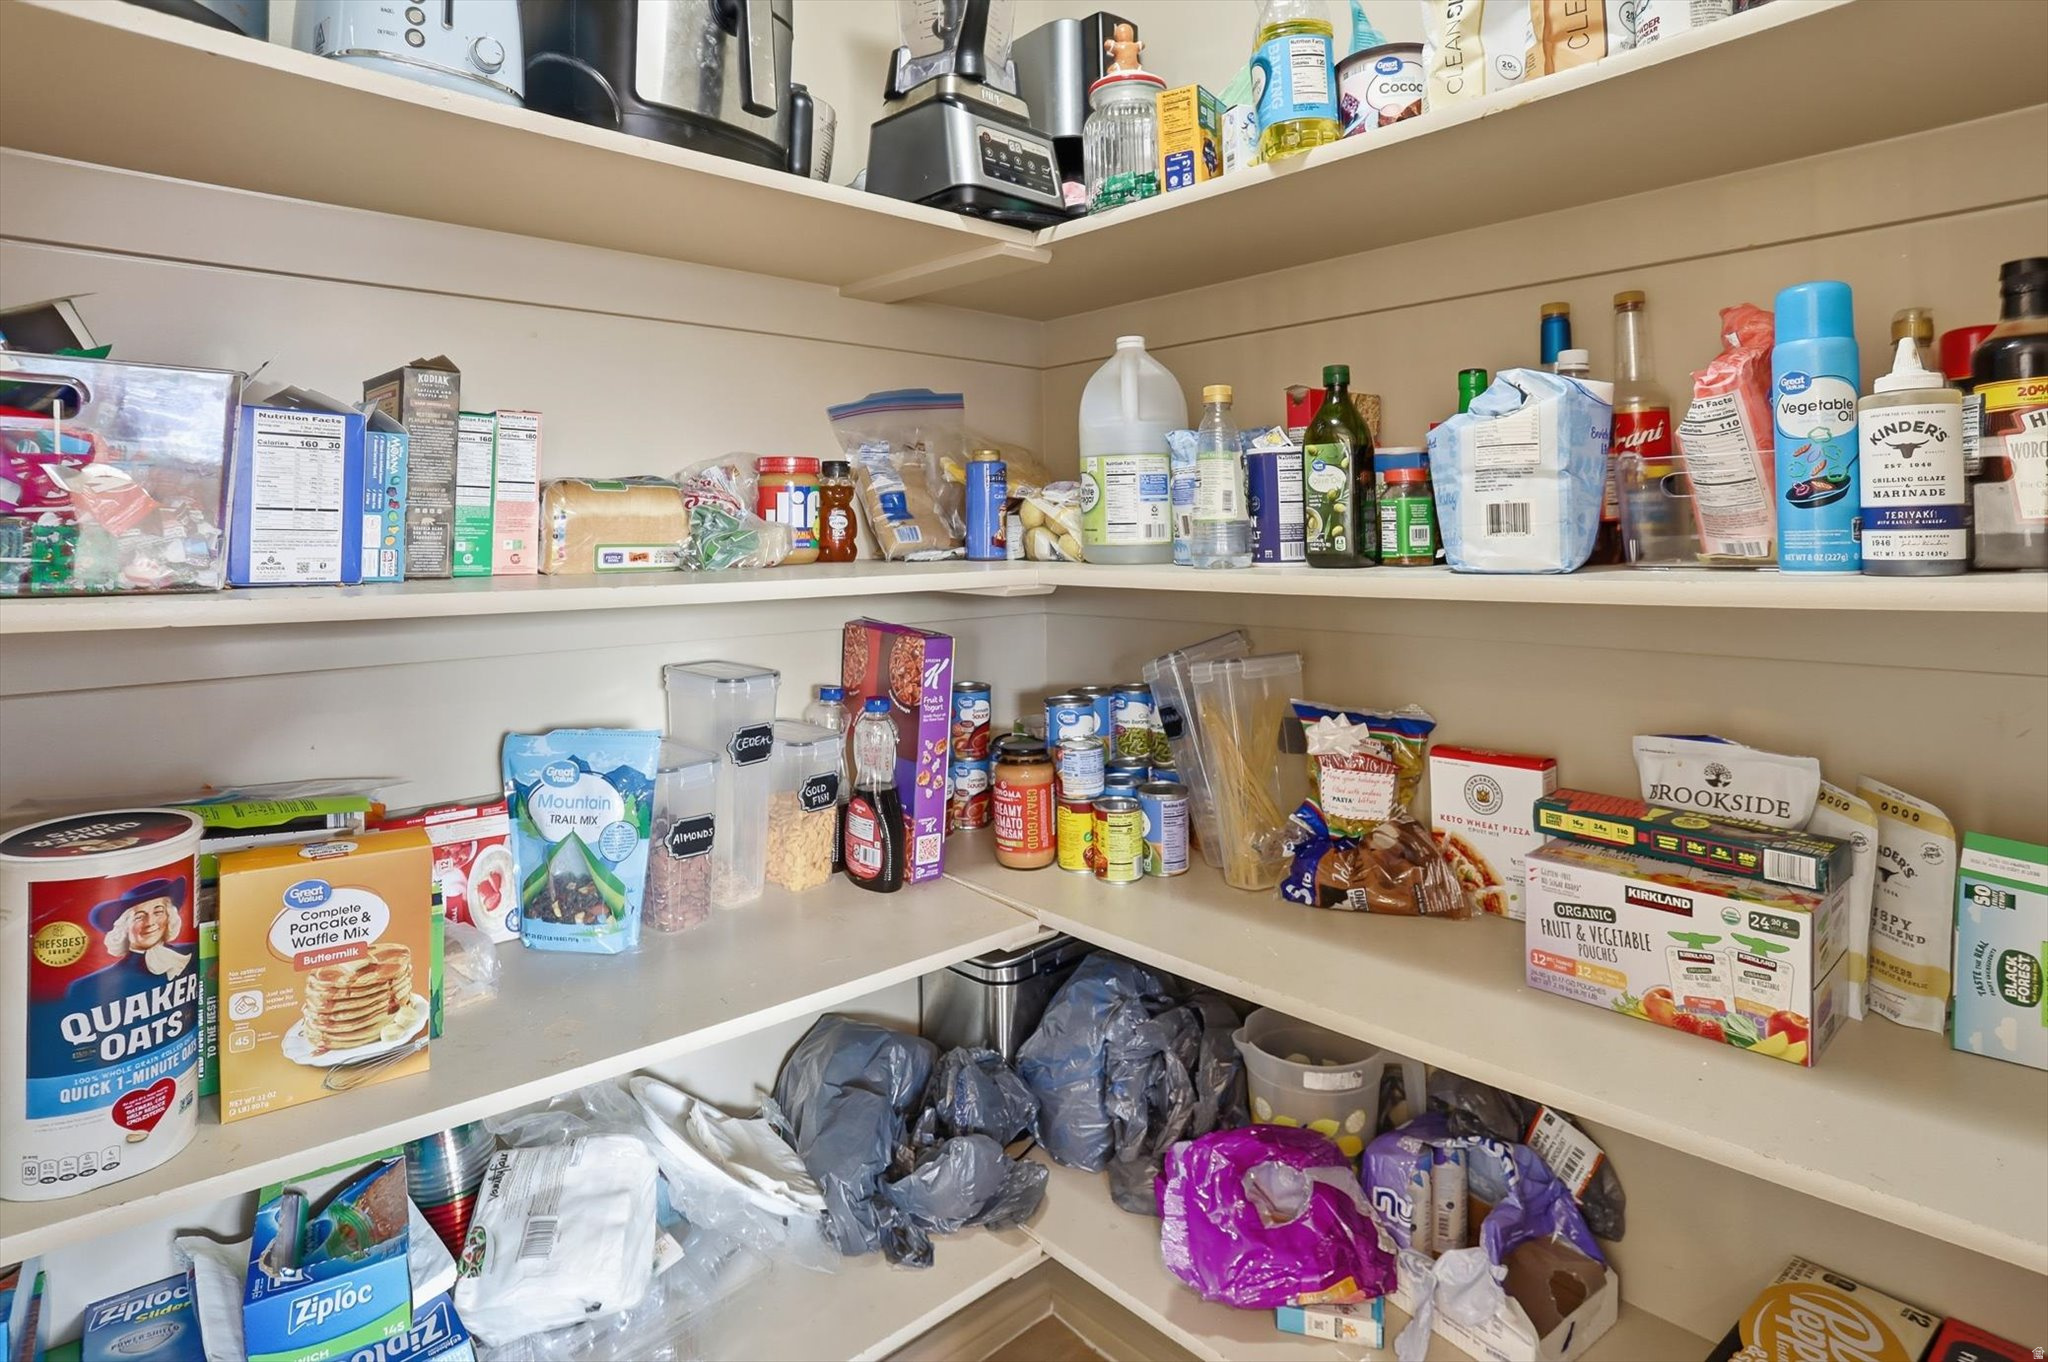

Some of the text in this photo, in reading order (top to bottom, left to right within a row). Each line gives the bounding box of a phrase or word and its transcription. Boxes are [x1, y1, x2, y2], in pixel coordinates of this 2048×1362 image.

[1636, 16, 1661, 34] OWDER
[1377, 60, 1398, 69] Great
[1267, 42, 1284, 109] BAKING
[418, 373, 449, 386] KODIAK
[1780, 375, 1805, 386] Great
[1706, 397, 1733, 408] Facts
[1781, 398, 1854, 416] Vegetable
[258, 412, 342, 424] Nutrition Facts
[1719, 419, 1740, 430] 110
[1838, 410, 1854, 422] Oil
[1869, 420, 1948, 446] KINDER'S
[257, 438, 289, 446] Calories
[300, 440, 319, 448] 160
[390, 435, 401, 475] MOANA
[1872, 476, 1914, 484] GRILLING
[1872, 488, 1946, 499] MARINADE
[1885, 509, 1934, 520] TERIYAKI
[924, 658, 949, 689] K
[923, 695, 938, 704] Fruit
[923, 703, 944, 713] Yogurt
[546, 766, 576, 777] Great
[805, 784, 827, 797] GOLD
[812, 791, 830, 805] FISH
[537, 792, 611, 811] Mountain
[1648, 783, 1791, 820] BROOKSIDE
[549, 813, 599, 826] TRAIL MIX
[1026, 788, 1039, 850] CRAZY GOOD
[1440, 814, 1531, 837] KETO WHEAT PIZZA
[289, 884, 324, 899] Great
[298, 893, 325, 904] Value
[1627, 887, 1691, 910] KIRKLAND
[1973, 883, 1992, 908] 50
[300, 903, 362, 921] Complete
[1557, 903, 1613, 921] ORGANIC
[1873, 906, 1912, 932] ISPY
[290, 911, 371, 936] Pancake &
[1750, 914, 1770, 930] 24
[34, 935, 87, 950] CHEFSBEST
[291, 926, 370, 949] Waffle Mix
[1540, 918, 1652, 952] FRUIT & VEGETABLE
[1881, 923, 1926, 945] BLEND
[303, 946, 359, 965] Buttermilk
[1532, 952, 1547, 966] 12
[1578, 943, 1618, 963] POUCHES
[1679, 951, 1714, 961] KIRKLAND
[1739, 952, 1776, 967] KIRKLAND
[1577, 965, 1592, 978] 12
[1973, 940, 1990, 998] TASTE REAL
[2004, 955, 2018, 998] BLACK
[2017, 953, 2032, 1004] FOREST
[60, 973, 197, 1046] QUAKER
[99, 1010, 183, 1062] OATS
[207, 1025, 217, 1043] THE
[207, 1045, 217, 1059] TO
[60, 1079, 111, 1104] QUICK
[117, 1054, 180, 1091] 1-MINUTE
[181, 1039, 198, 1061] OATS
[74, 1074, 98, 1086] 100%
[101, 1064, 133, 1081] WHOLE
[134, 1055, 160, 1071] GRAIN
[24, 1166, 37, 1176] 150
[99, 1286, 189, 1325] Ziploc
[134, 1300, 193, 1324] Slider
[296, 1283, 374, 1326] Ziploc
[350, 1312, 444, 1362] Ziplo
